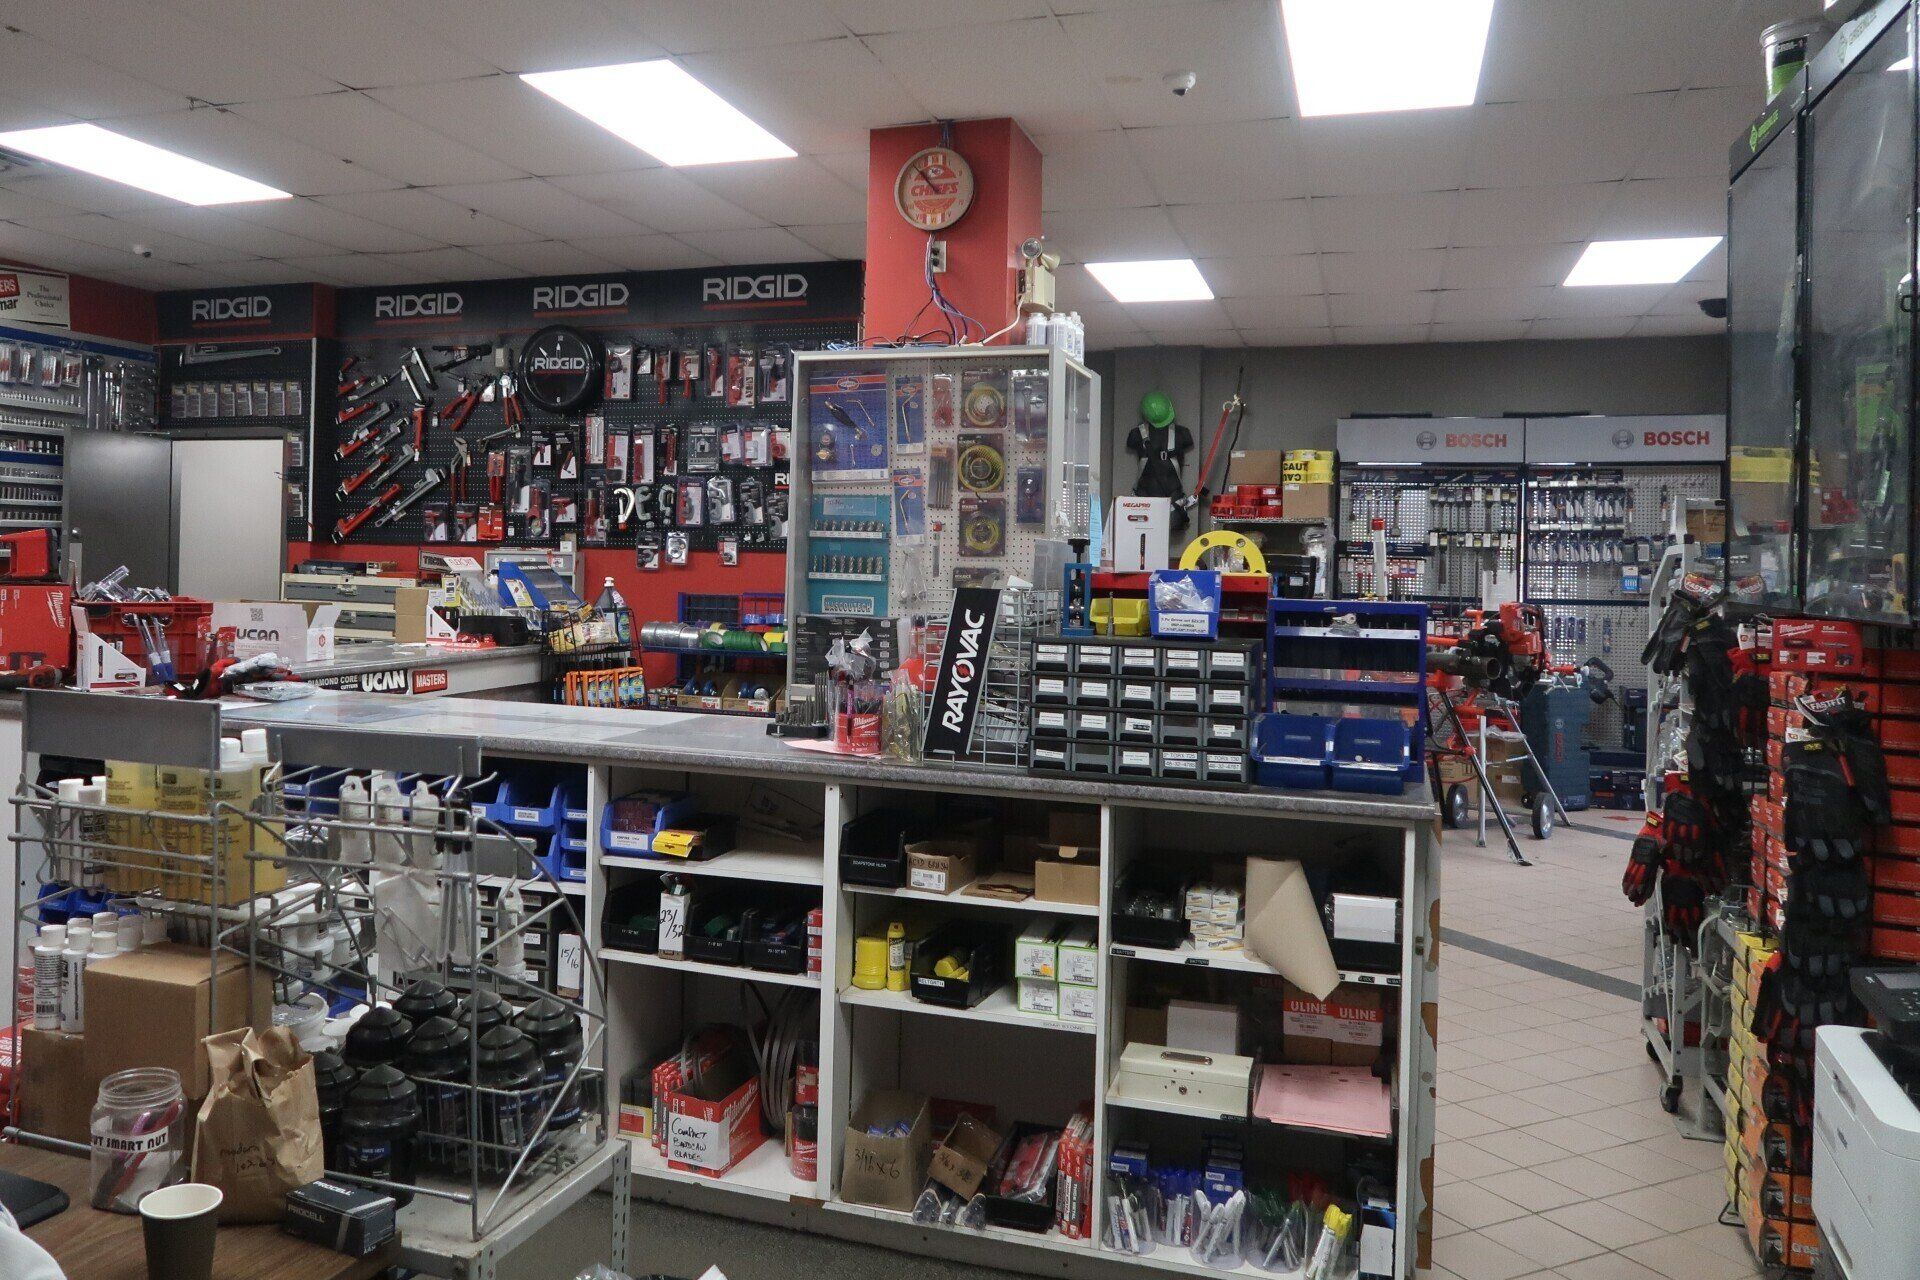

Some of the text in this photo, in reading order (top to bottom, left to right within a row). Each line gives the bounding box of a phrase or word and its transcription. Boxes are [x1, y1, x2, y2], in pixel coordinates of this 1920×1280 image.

[533, 283, 630, 310] RIDGID
[703, 274, 809, 302] RIDGID
[192, 296, 272, 321] RIDGID
[376, 292, 464, 317] RIDGID
[534, 357, 586, 370] RIDGID
[1446, 434, 1507, 448] BOSCH
[1644, 431, 1710, 446] BOSCH
[51, 590, 66, 629] Milwaukee
[340, 674, 358, 684] CORE
[362, 670, 405, 692] UCAN
[416, 673, 446, 687] MASTERS
[942, 608, 985, 734] RAYOVAC
[1809, 697, 1846, 711] FASTFIT
[659, 909, 686, 939] 23/32
[1290, 1001, 1327, 1014] ULINE
[1339, 1007, 1377, 1021] ULINE
[724, 1082, 759, 1121] Milwaukee
[313, 1180, 355, 1196] PROCELL
[288, 1204, 325, 1224] PROCELL
